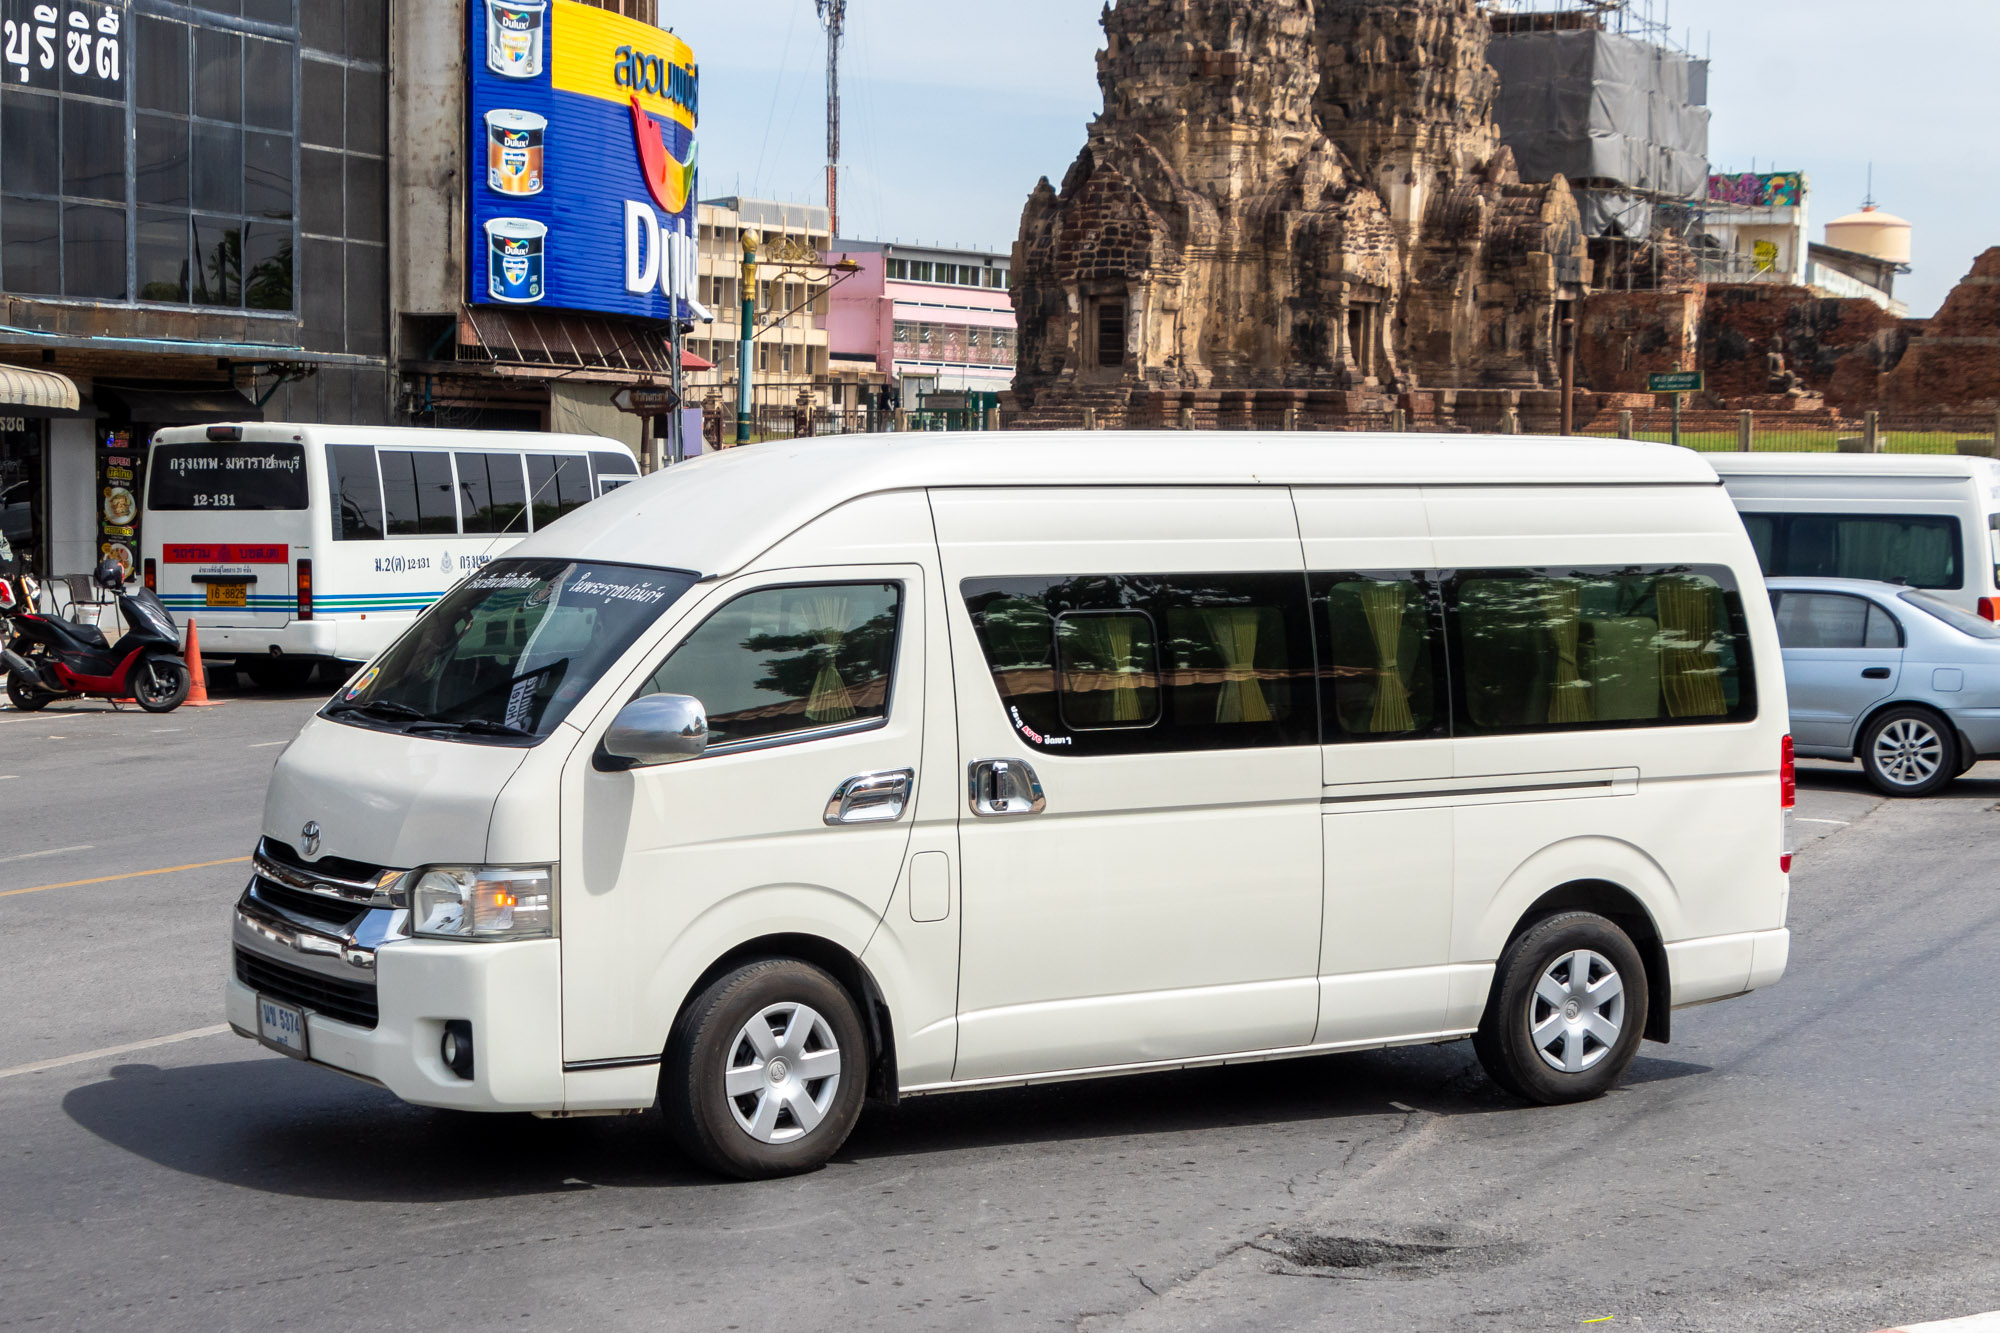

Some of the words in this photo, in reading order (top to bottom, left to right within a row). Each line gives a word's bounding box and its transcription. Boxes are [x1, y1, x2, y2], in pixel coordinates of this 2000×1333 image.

[502, 16, 529, 30] Dulux
[504, 136, 528, 148] Dulux
[504, 245, 527, 256] Dulux
[625, 199, 698, 301] Dulu
[108, 456, 131, 467] OPEN
[193, 494, 236, 506] 12-131
[1021, 725, 1043, 744] AUTO
[279, 1009, 300, 1035] 5374
